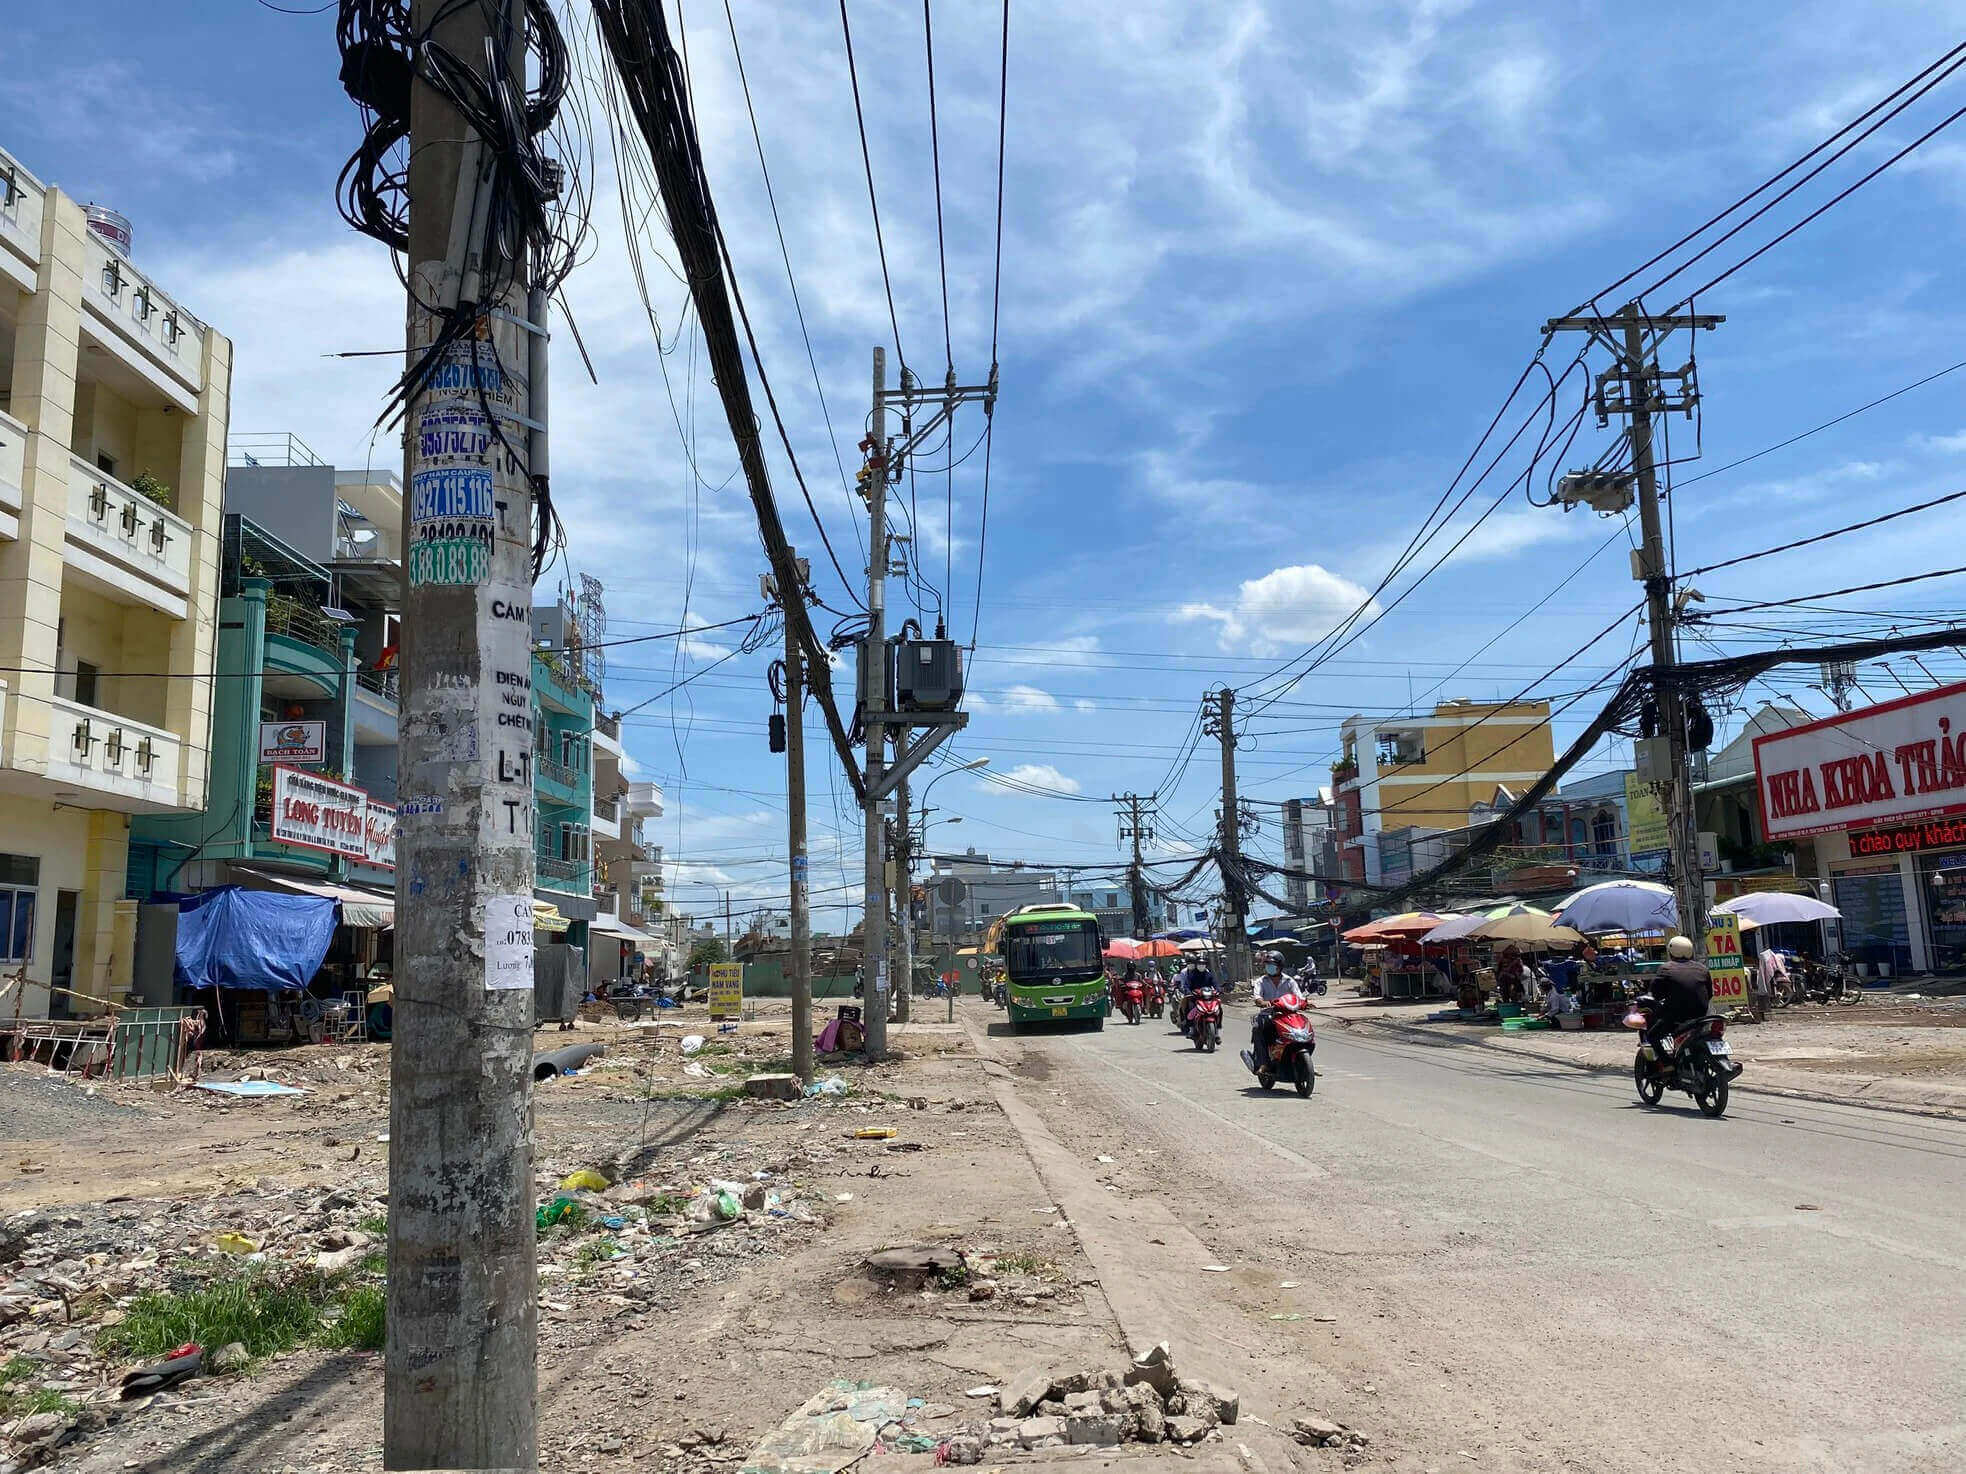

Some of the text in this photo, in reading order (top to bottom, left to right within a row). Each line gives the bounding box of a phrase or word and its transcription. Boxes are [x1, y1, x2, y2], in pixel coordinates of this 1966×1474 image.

[1767, 768, 1820, 819] NHA
[1820, 751, 1896, 810] KHOA
[283, 797, 319, 826] LONG
